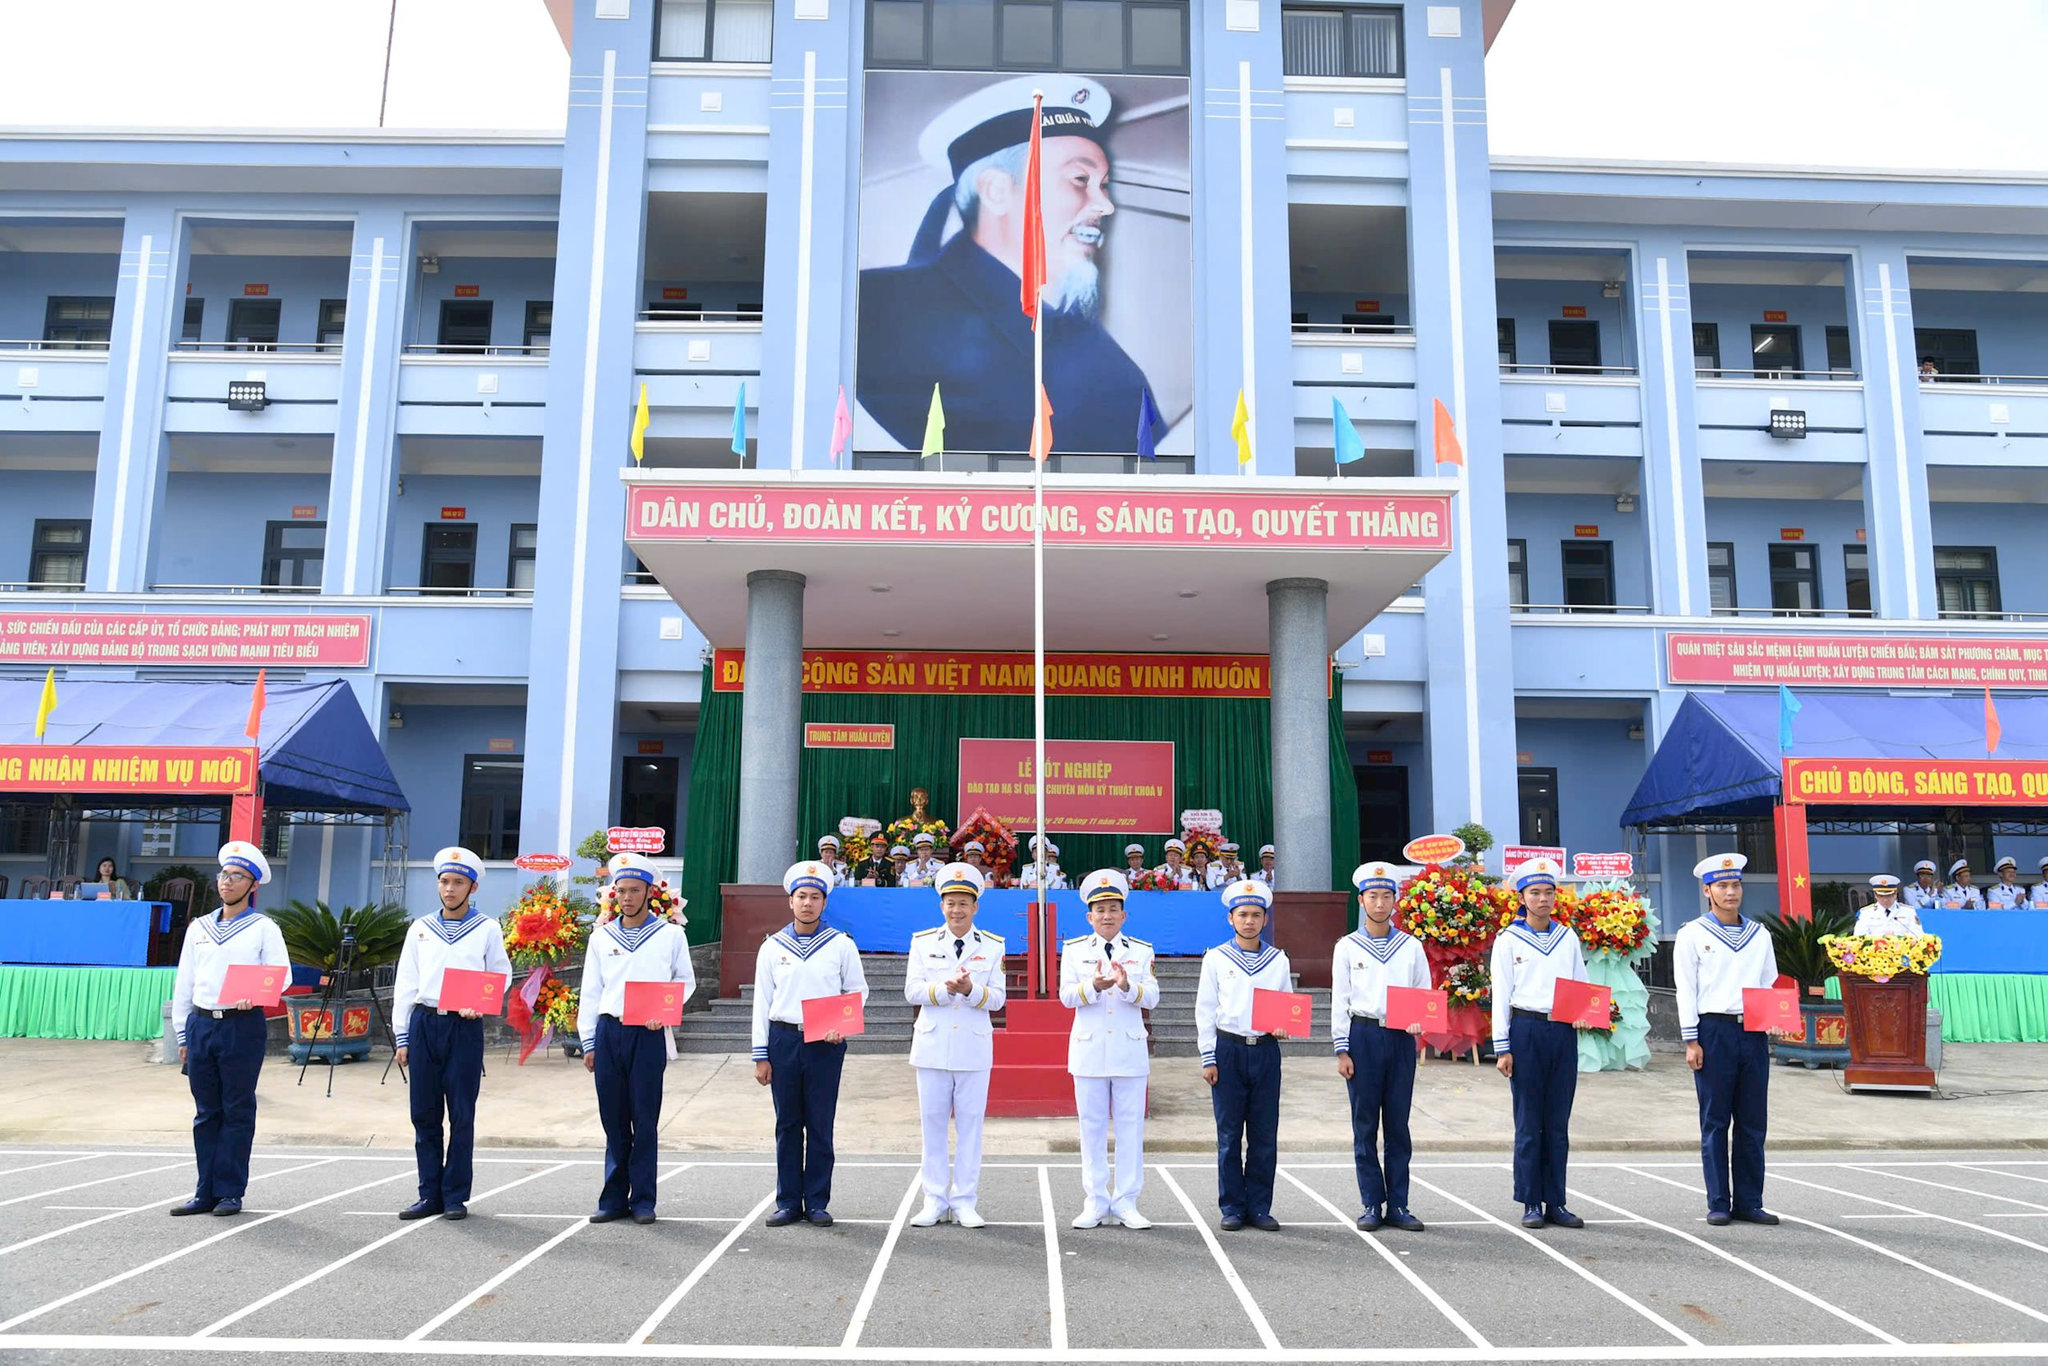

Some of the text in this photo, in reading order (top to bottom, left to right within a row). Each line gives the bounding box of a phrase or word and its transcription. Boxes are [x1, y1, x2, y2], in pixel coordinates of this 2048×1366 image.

[641, 494, 1438, 540] DÂN CHỦ, ĐOÀN KẾT, KỶ CƯƠNG, SÁNG TẠO, QUYẾT THẮNG
[7, 619, 27, 634] SỨC
[30, 618, 60, 634] CHIẾN
[62, 619, 82, 635] ĐẤU
[84, 620, 103, 636] CỦA
[106, 620, 126, 636] CÁC
[128, 619, 148, 636] CẤP
[182, 620, 208, 636] CHỨC
[211, 620, 240, 638] ĐẢNG;
[243, 622, 268, 637] PHÁT
[271, 624, 290, 637] HUY
[293, 622, 324, 638] TRÁCH
[327, 622, 360, 640] NHIỆM
[22, 640, 48, 656] VIÊN;
[50, 641, 69, 656] XÂY
[72, 642, 99, 658] DỰNG
[102, 640, 128, 656] ĐẢNG
[131, 641, 144, 659] BỘ
[148, 644, 179, 656] TRONG
[182, 645, 208, 660] SẠCH
[212, 642, 237, 657] VỮNG
[240, 645, 270, 660] MẠNH
[273, 642, 294, 658] TIÊU
[296, 640, 319, 658] BIỂU
[1702, 641, 1725, 658] TRIỆT
[1728, 641, 1744, 656] SÂU
[1766, 642, 1791, 659] MỆNH
[1794, 643, 1815, 660] LỆNH
[1817, 642, 1840, 658] HUẤN
[1842, 644, 1868, 662] LUYỆN
[1871, 643, 1896, 658] CHIẾN
[1941, 645, 1956, 660] SÁT
[1958, 646, 1992, 660] PHƯƠNG
[2024, 648, 2042, 664] MỤC
[802, 656, 857, 690] CỘNG
[866, 654, 915, 686] SẢN
[923, 658, 972, 690] VIỆT
[980, 664, 1035, 686] NAM
[1044, 664, 1121, 688] QUANG
[1129, 666, 1184, 689] VINH
[1192, 662, 1260, 689] MUÔN
[1733, 662, 1761, 680] NHIỆM
[1763, 665, 1774, 680] VỤ
[1776, 662, 1800, 678] HUẤN
[1833, 663, 1849, 678] XÂY
[1852, 665, 1874, 681] DỰNG
[1877, 666, 1904, 680] TRUNG
[1906, 665, 1924, 680] TÂM
[1926, 666, 1948, 680] CÁCH
[1981, 666, 2007, 680] CHÍNH
[2028, 668, 2048, 680] TINH
[809, 730, 831, 742] TRUNG
[28, 755, 86, 786] NHẬN
[92, 756, 158, 786] NHIỆM
[166, 760, 194, 786] VỤ
[200, 756, 242, 783] MỚI
[1018, 756, 1112, 782] LỄ ỐT NGHIỆP
[1800, 765, 1842, 794] CHỦ
[1848, 768, 1909, 798] ĐỘNG,
[1914, 769, 1968, 795] SÁNG
[1974, 773, 2016, 800] TẠO,
